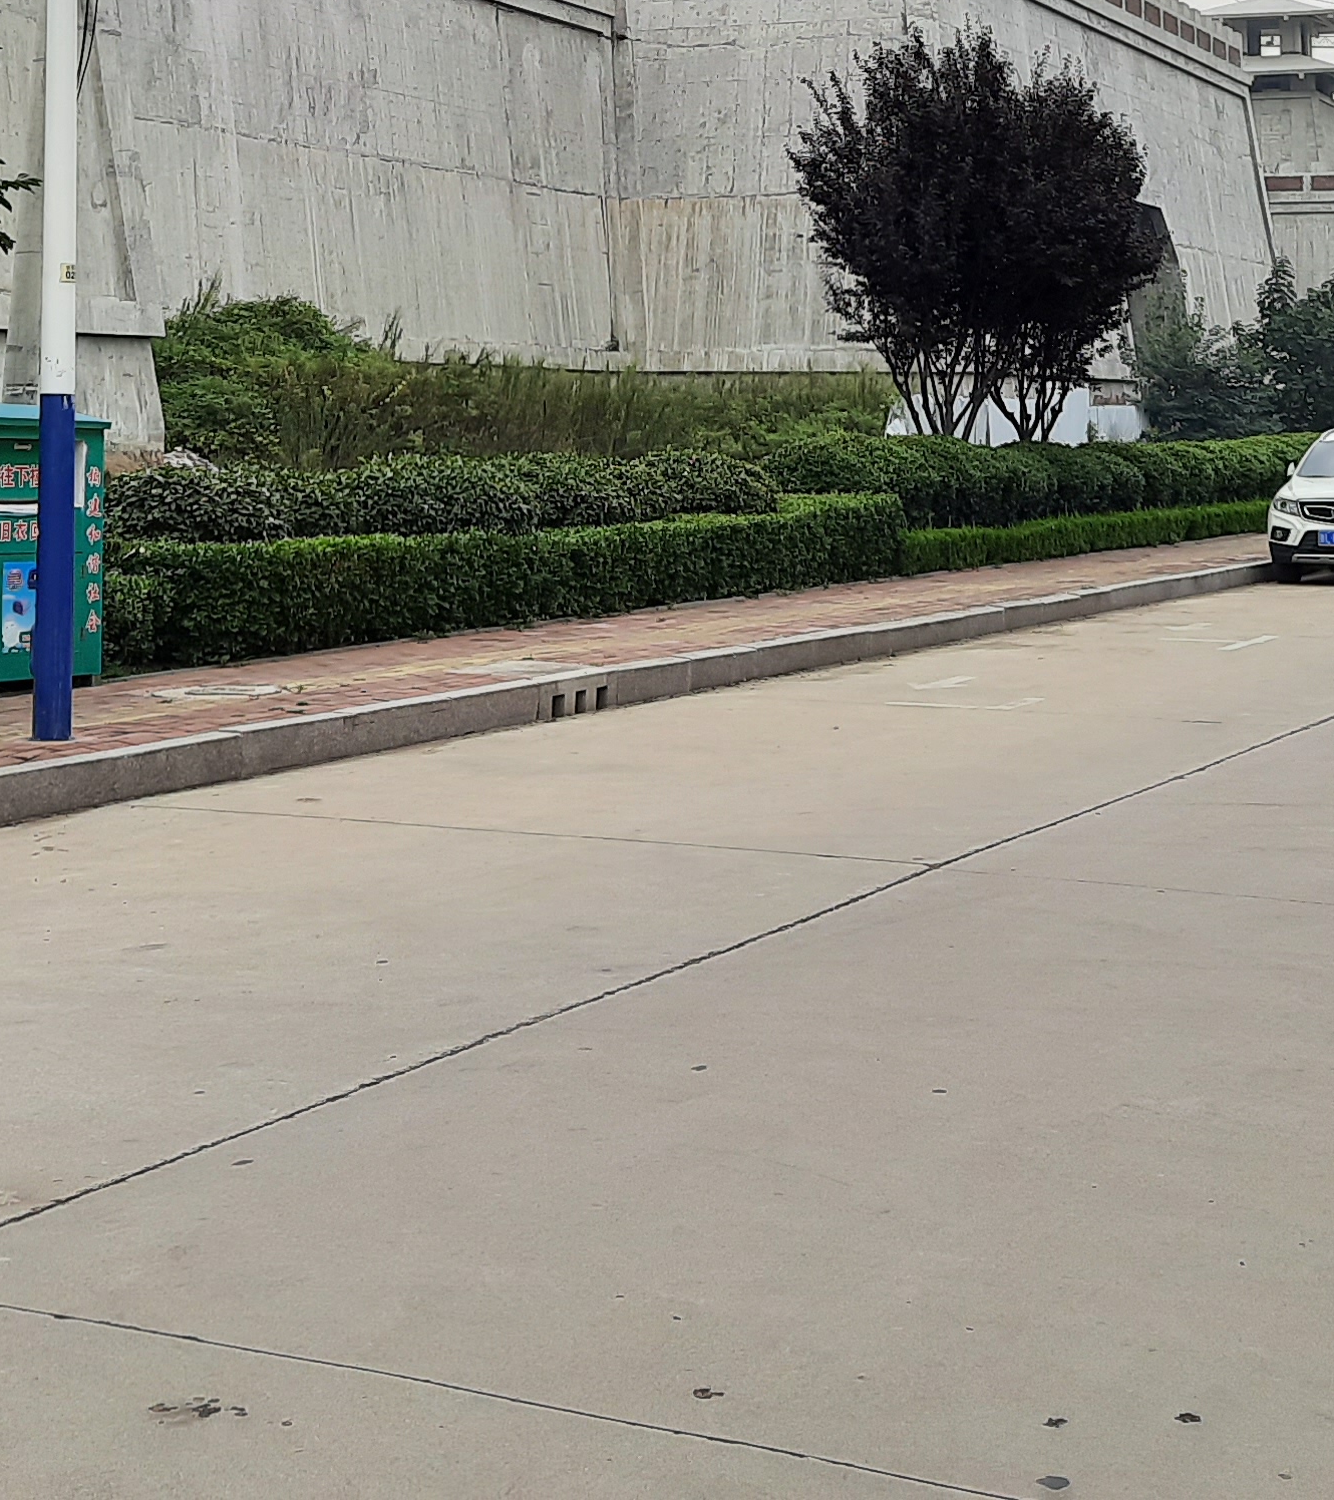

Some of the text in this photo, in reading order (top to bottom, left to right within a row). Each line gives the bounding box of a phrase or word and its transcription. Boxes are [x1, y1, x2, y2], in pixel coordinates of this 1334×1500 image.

[86, 466, 102, 633] 构建和谐社会
